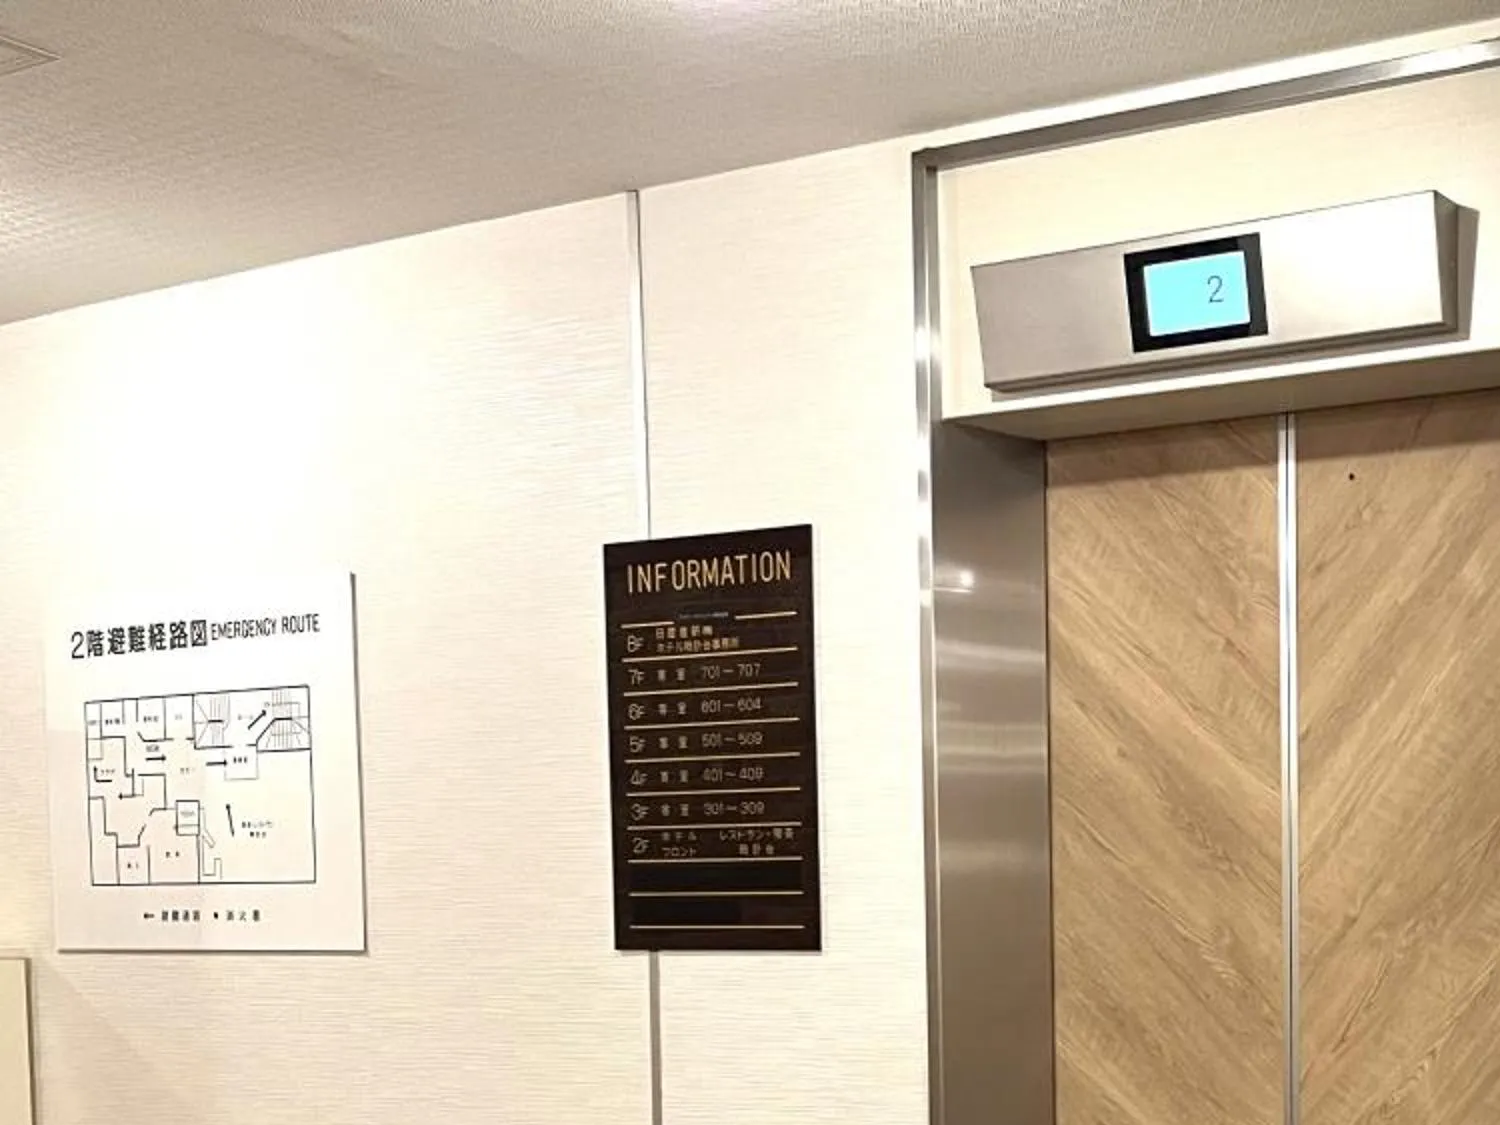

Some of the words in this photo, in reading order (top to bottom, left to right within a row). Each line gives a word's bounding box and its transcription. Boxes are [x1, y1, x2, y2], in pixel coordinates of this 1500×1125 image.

[1207, 275, 1224, 303] 2
[627, 550, 791, 593] INFORMATION
[211, 617, 277, 641] EMERGENCY
[282, 613, 320, 634] ROUTE
